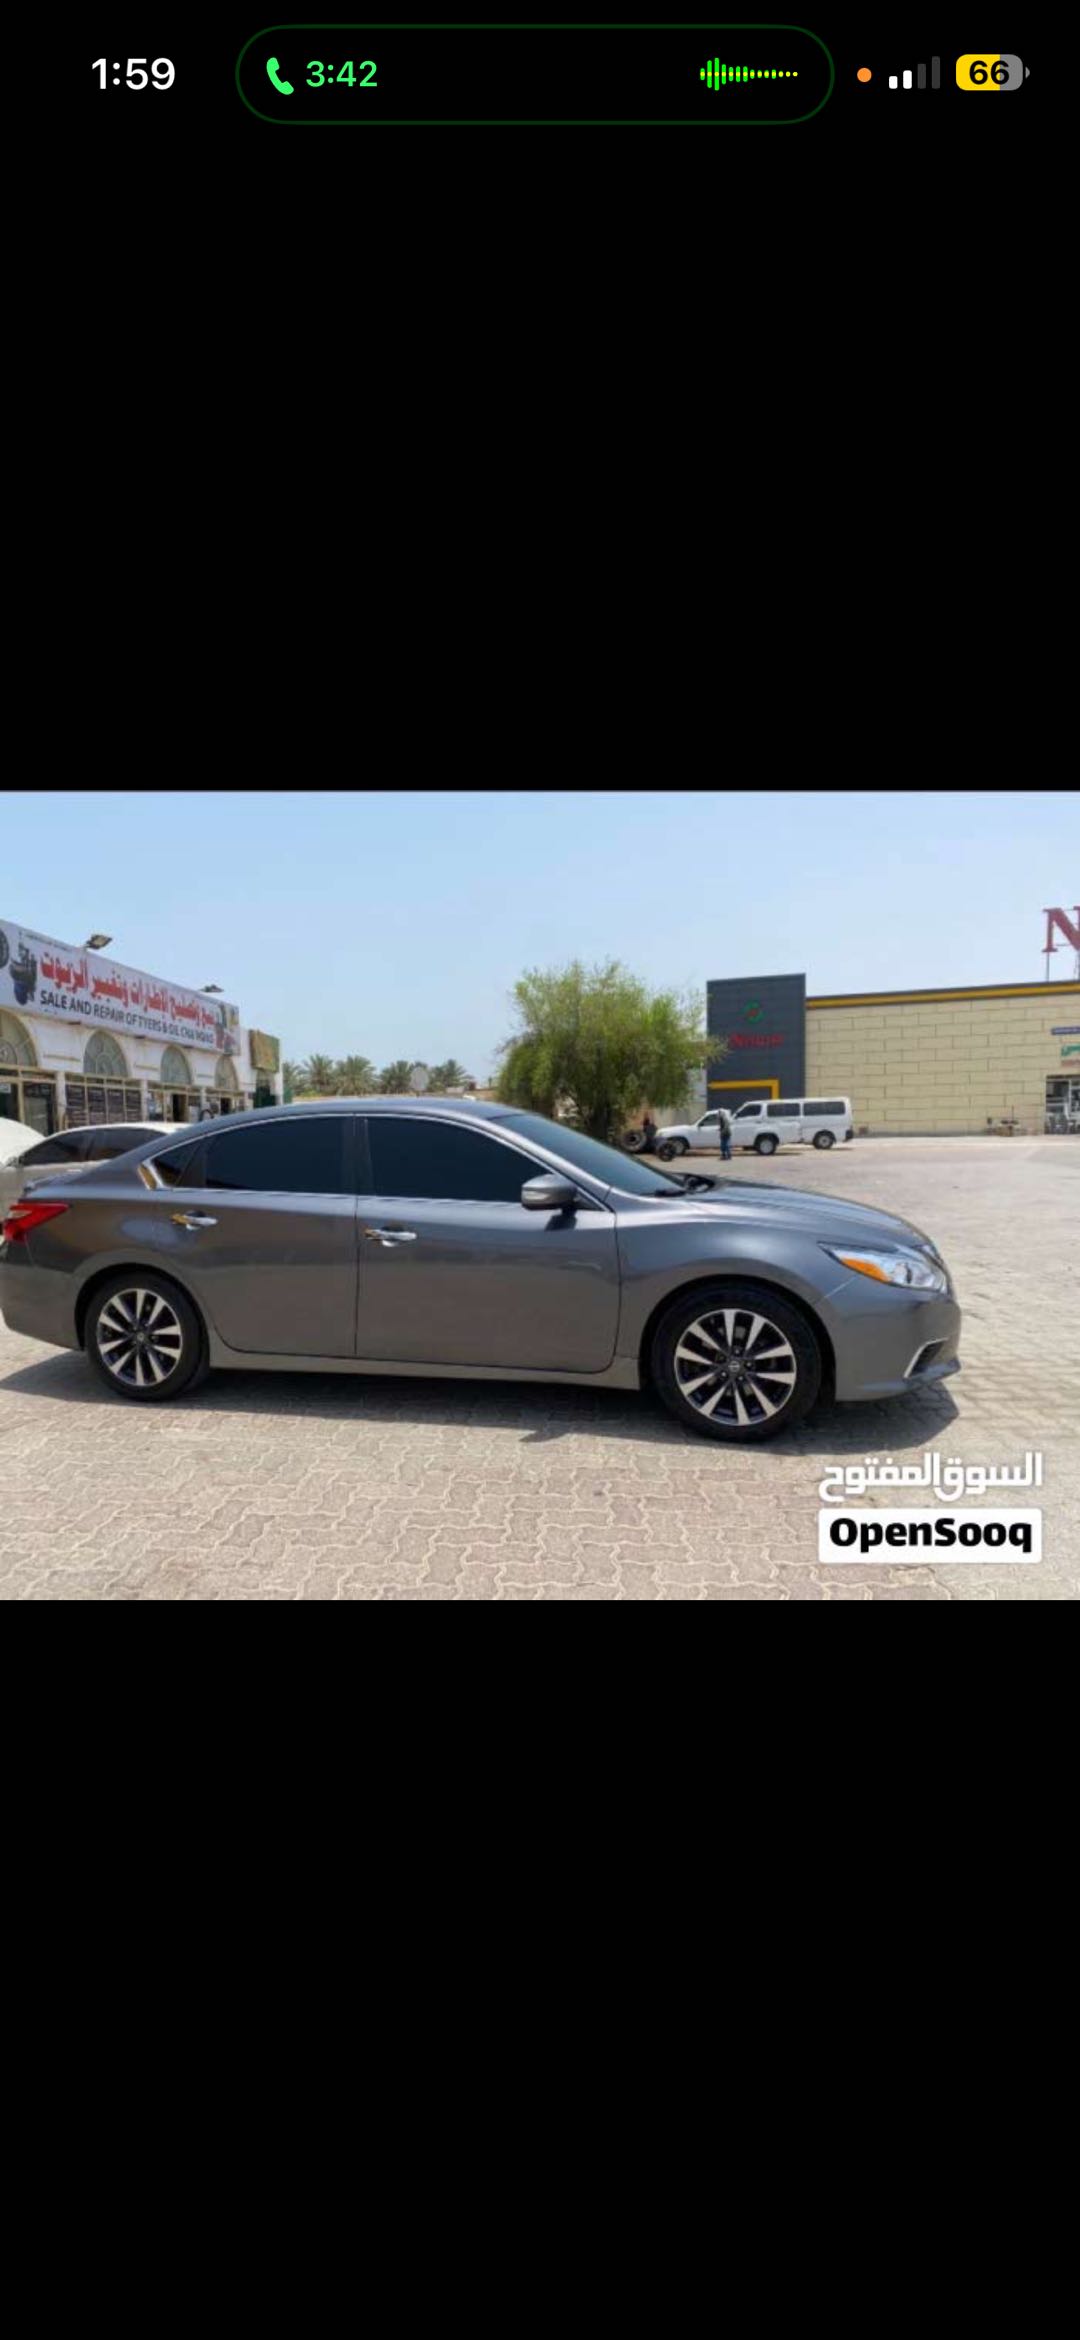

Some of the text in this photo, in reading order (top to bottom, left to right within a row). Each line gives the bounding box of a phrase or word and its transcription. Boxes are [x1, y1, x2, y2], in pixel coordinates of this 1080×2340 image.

[41, 989, 68, 1009] SALE
[69, 998, 91, 1016] AND
[93, 1003, 126, 1024] REPAIR
[126, 1012, 138, 1025] OF
